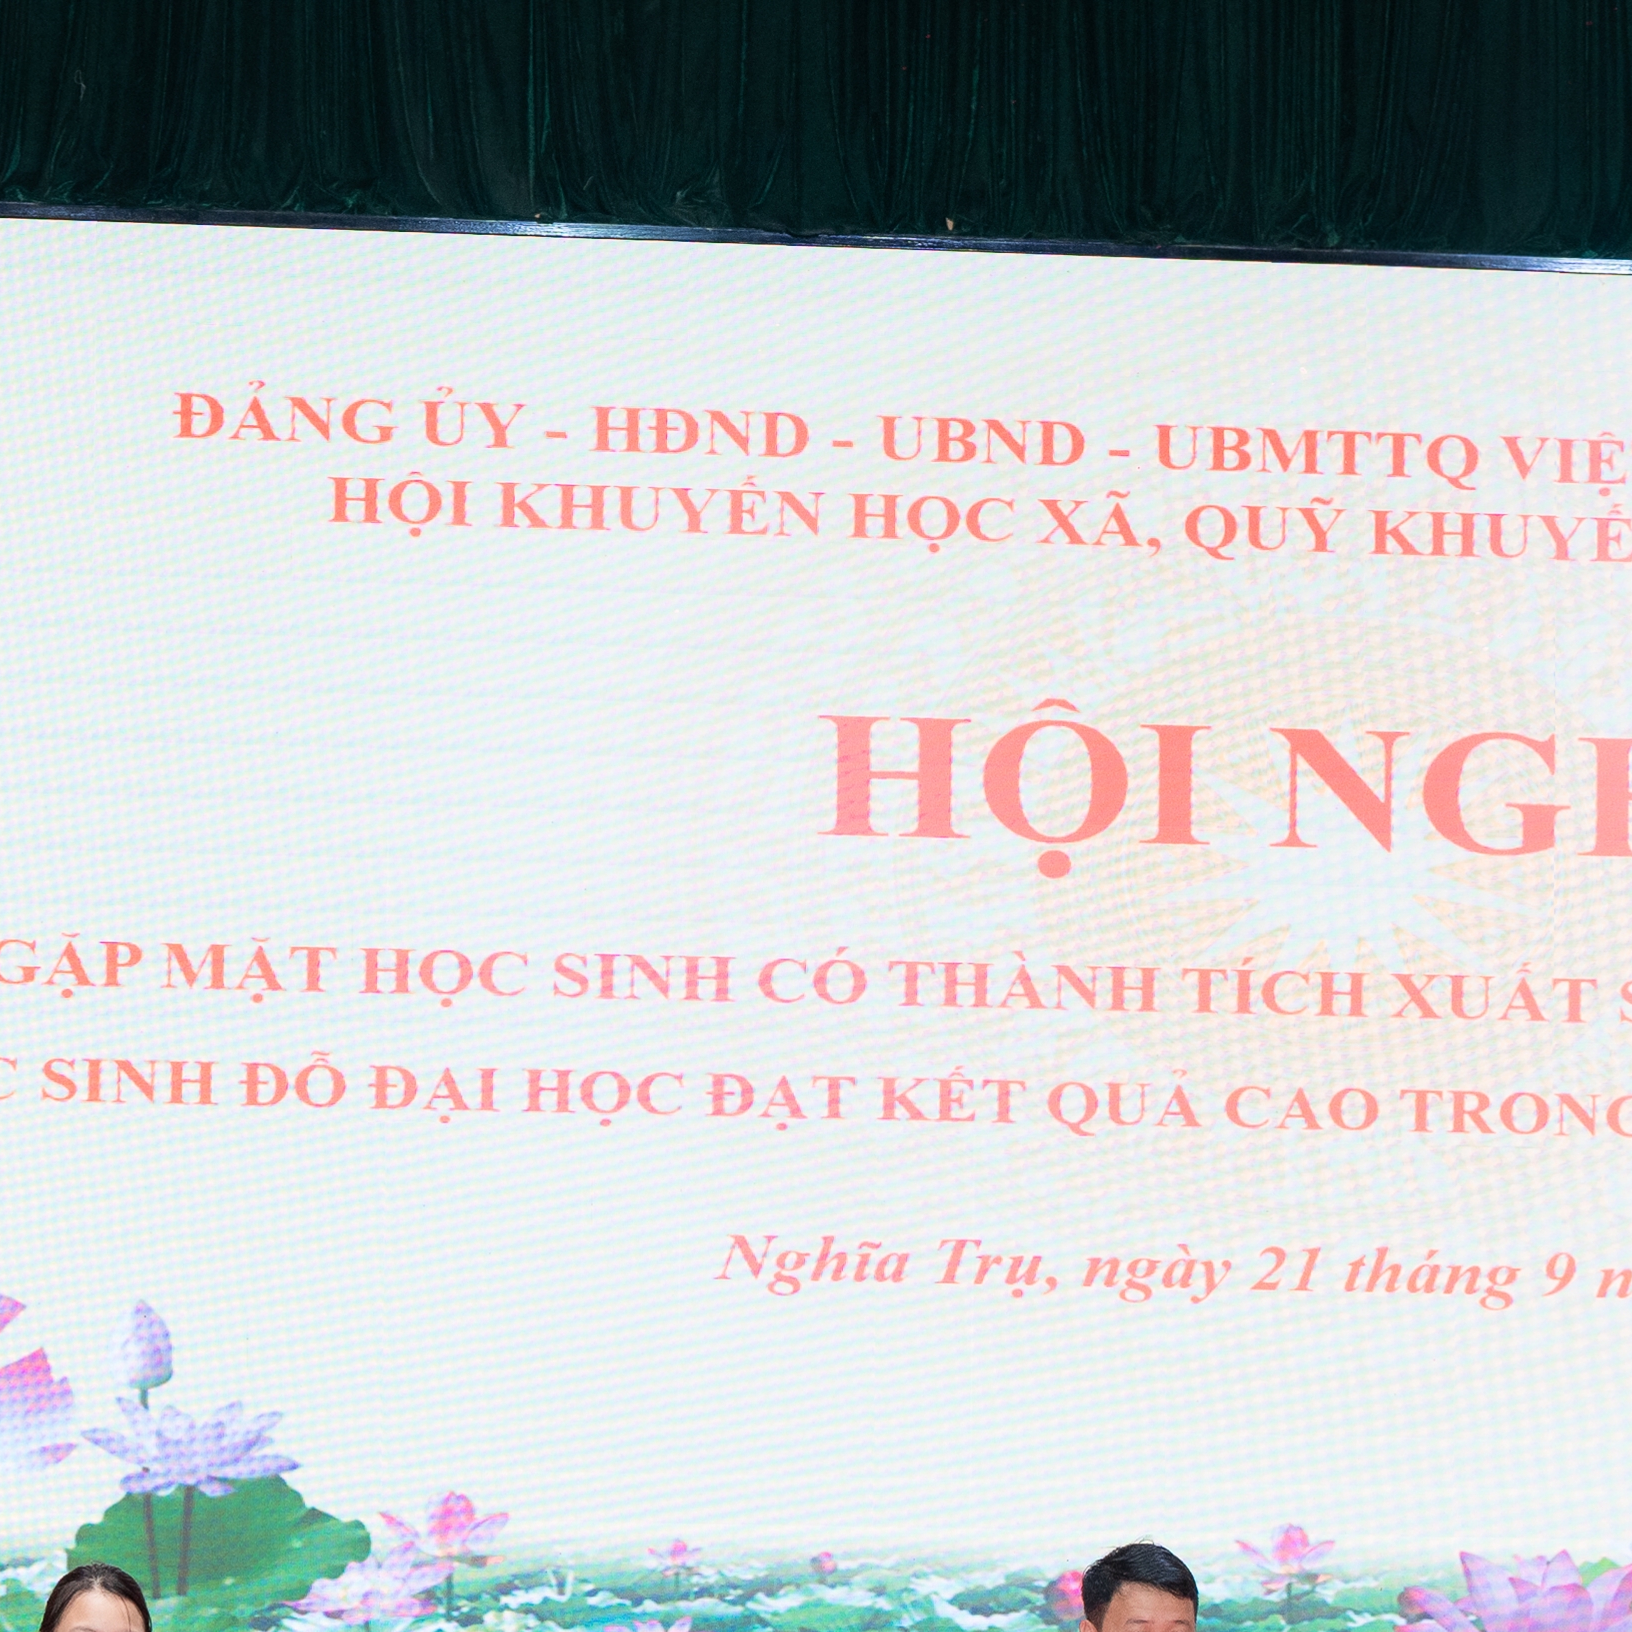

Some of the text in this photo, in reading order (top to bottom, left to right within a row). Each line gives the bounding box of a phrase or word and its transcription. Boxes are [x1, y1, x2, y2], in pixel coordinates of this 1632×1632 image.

[173, 378, 397, 446] ĐẢNG
[423, 384, 525, 449] ỦY
[593, 406, 809, 458] HĐND
[879, 416, 1085, 466] UBND
[1155, 424, 1479, 490] UBMTTQ
[329, 471, 472, 537] HỘI
[498, 476, 825, 539] KHUYẾN
[851, 494, 1014, 554] HỌC
[1038, 490, 1161, 558] XÃ,
[1185, 497, 1345, 560] QUỸ
[818, 698, 1212, 879] HỘI
[160, 938, 338, 1003] MẶT
[359, 948, 528, 1007] HỌC
[552, 953, 732, 1003] SINH
[758, 951, 869, 1006] CÓ
[889, 951, 1160, 1013] THÀNH
[1182, 957, 1366, 1019] TÍCH
[1392, 962, 1597, 1025] XUẤT
[40, 1058, 216, 1106] SINH
[240, 1049, 347, 1108] ĐỖ
[369, 1065, 498, 1123] ĐẠI
[522, 1069, 683, 1126] HỌC
[707, 1073, 855, 1130] ĐẠT
[878, 1064, 1026, 1125] KẾT
[1048, 1075, 1201, 1138] QUẢ
[1224, 1085, 1380, 1132] CAO
[716, 1235, 910, 1297] Nghĩa
[940, 1239, 1059, 1299] Trụ,
[1083, 1244, 1231, 1306] ngày
[1251, 1245, 1321, 1292] 21
[1345, 1246, 1520, 1310] tháng
[1544, 1253, 1576, 1297] 9
